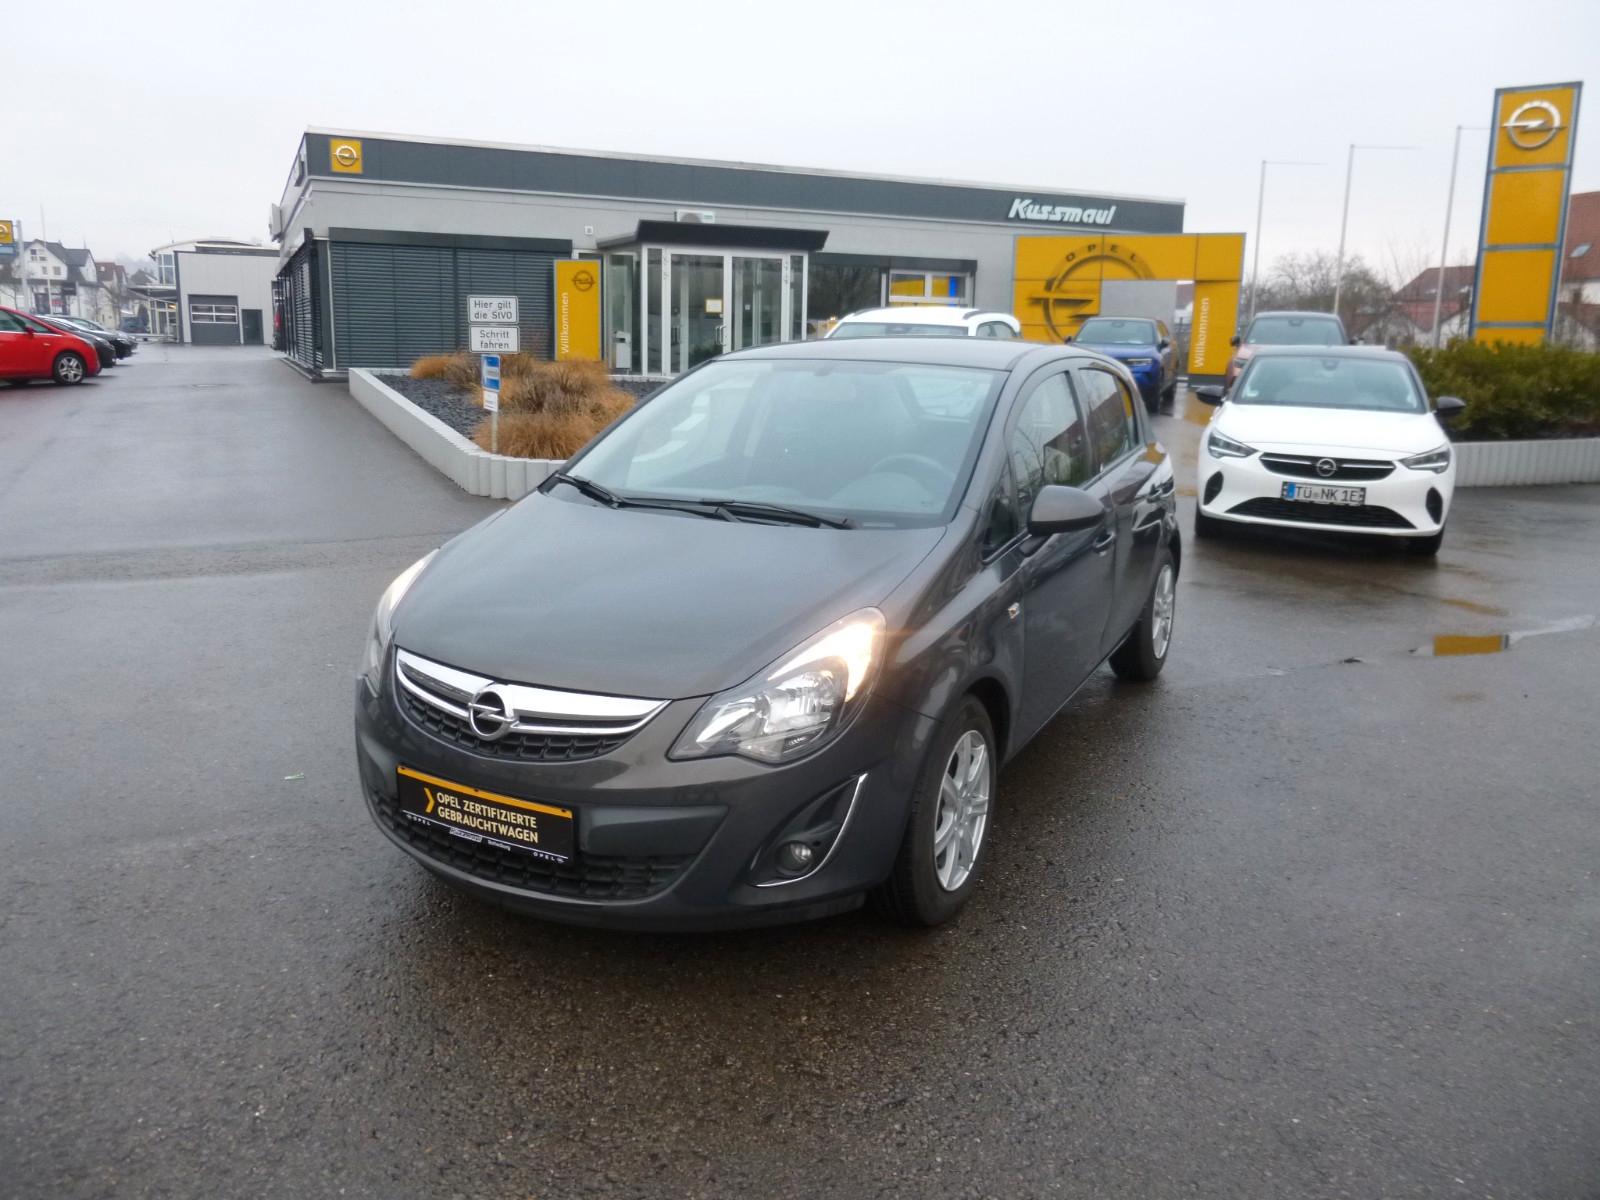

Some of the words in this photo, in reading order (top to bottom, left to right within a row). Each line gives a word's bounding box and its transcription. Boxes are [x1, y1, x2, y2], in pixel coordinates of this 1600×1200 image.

[1008, 198, 1117, 225] Kussmaul
[1065, 243, 1137, 263] OPEL
[474, 300, 493, 309] Hier
[497, 301, 512, 311] gilt
[474, 311, 488, 320] die
[491, 311, 513, 320] StVO
[560, 292, 569, 354] Willkommen
[480, 329, 509, 339] Schritt
[1194, 296, 1209, 368] Willkommen
[480, 340, 510, 350] fahren
[1296, 485, 1313, 499] TÜ
[1320, 487, 1338, 501] NK
[436, 791, 461, 809] OPEL
[463, 799, 538, 829] ZERTIFIZIERTE
[437, 806, 539, 843] GEBRAUCHTWAGEN
[533, 851, 555, 861] OPEL
